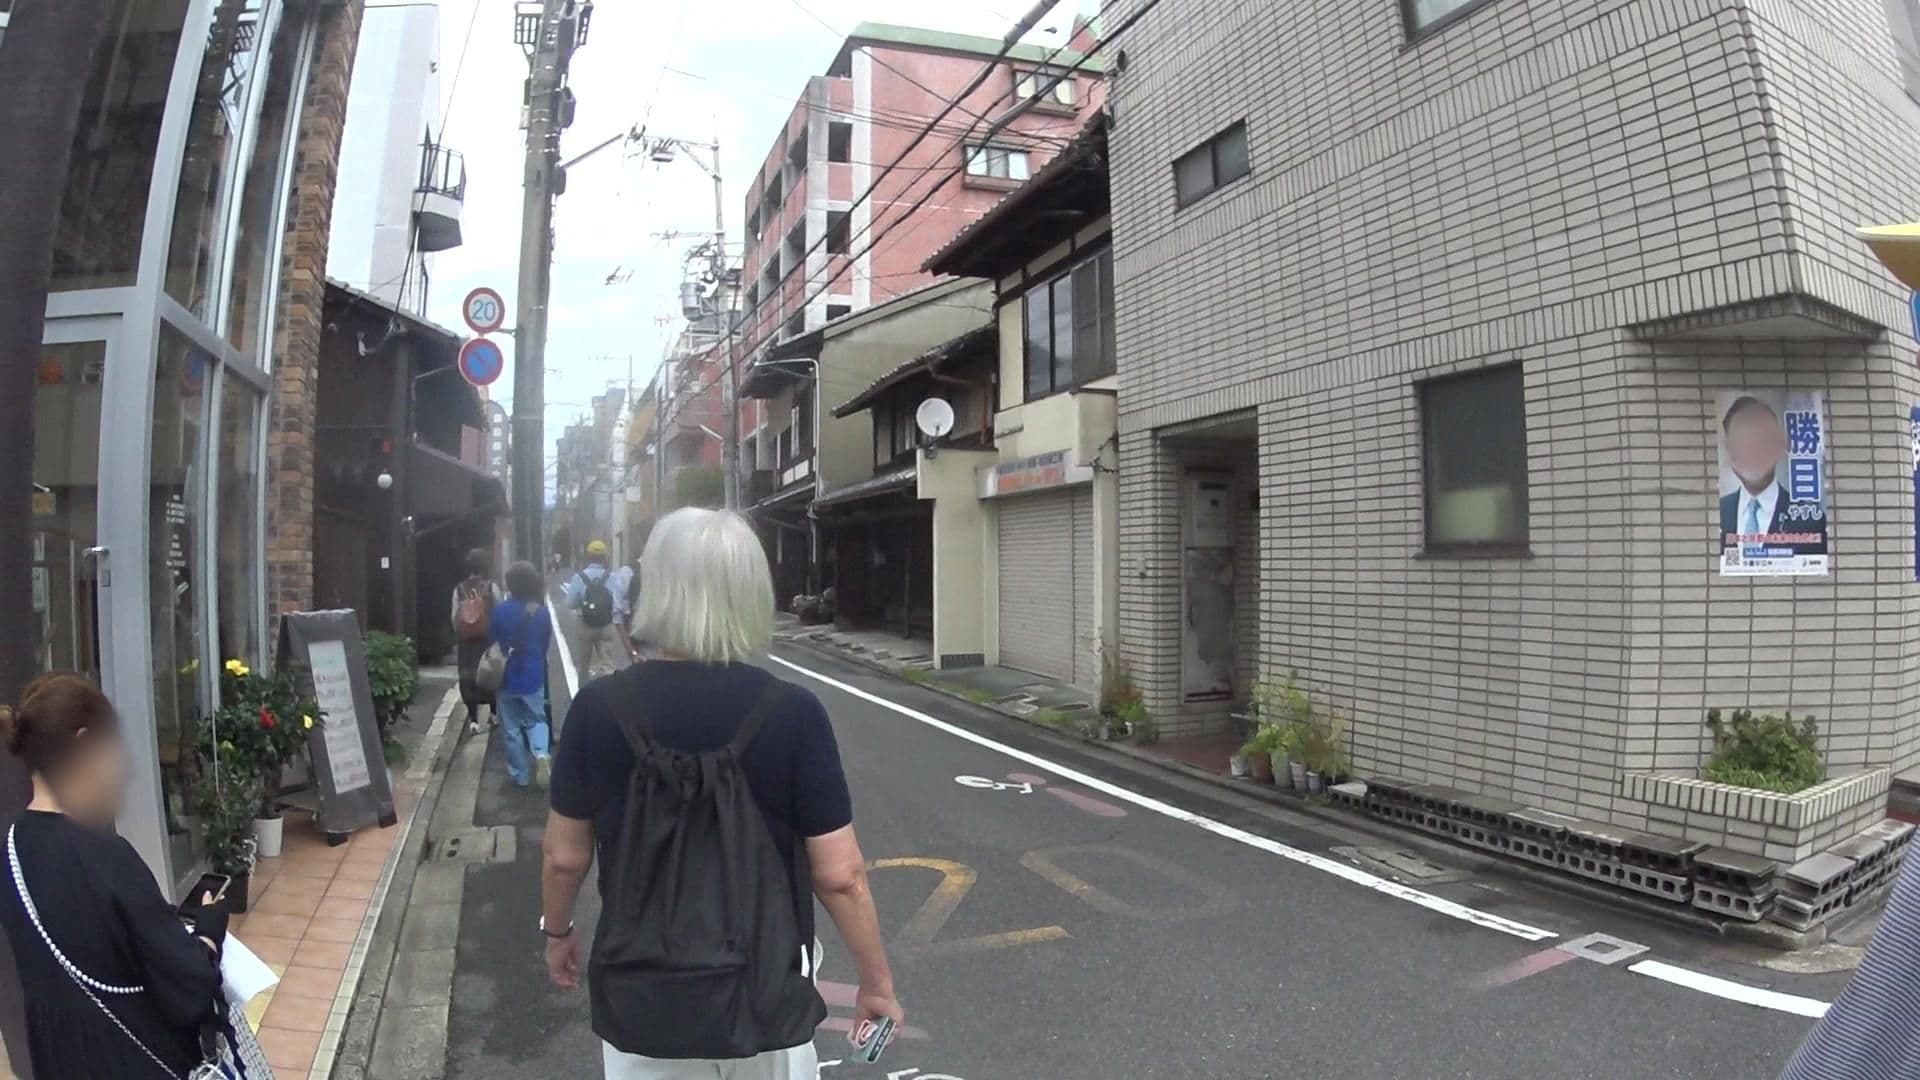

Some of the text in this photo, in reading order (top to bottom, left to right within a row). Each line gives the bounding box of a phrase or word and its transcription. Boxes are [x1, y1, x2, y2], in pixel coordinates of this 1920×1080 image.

[472, 299, 496, 321] 20
[1785, 411, 1821, 502] 勝目
[1788, 504, 1822, 521] やすし
